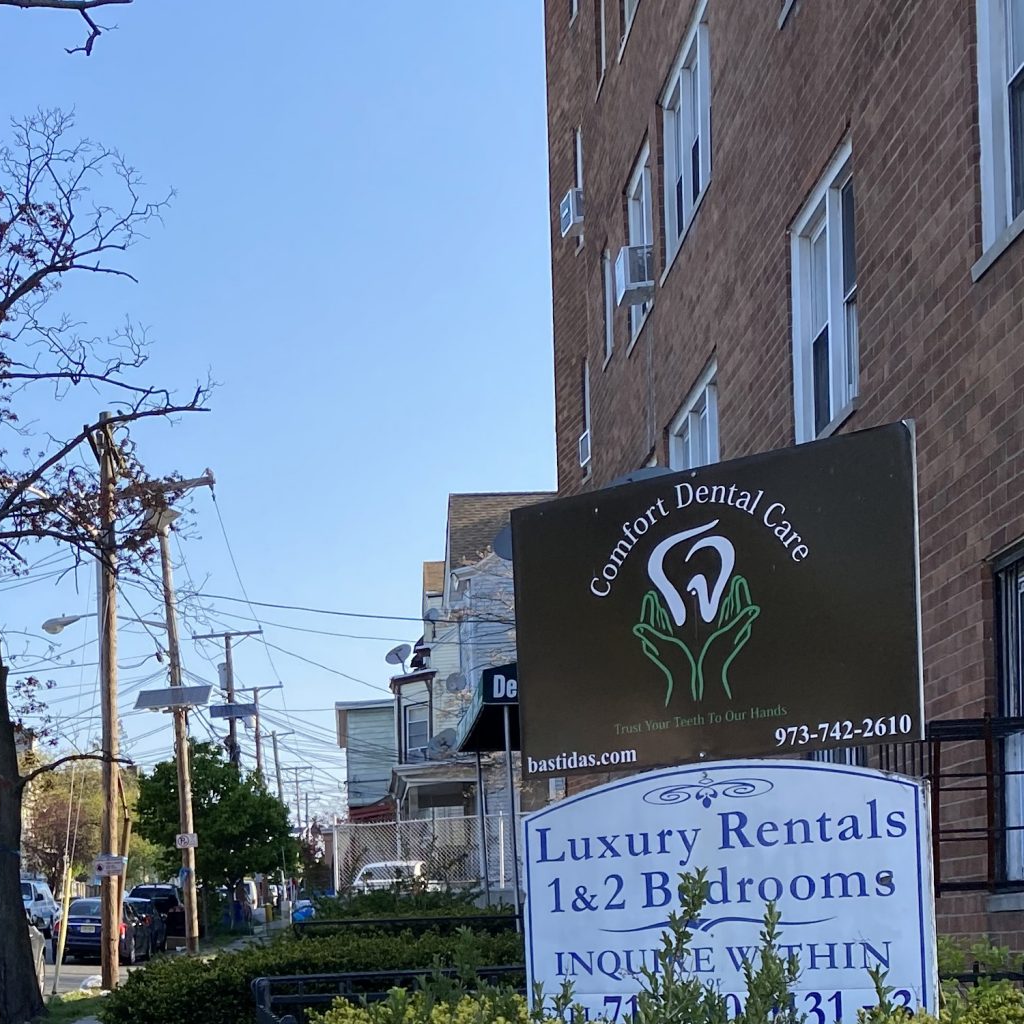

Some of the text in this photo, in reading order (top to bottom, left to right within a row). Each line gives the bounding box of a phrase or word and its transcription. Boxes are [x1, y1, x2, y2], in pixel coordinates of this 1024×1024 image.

[590, 482, 810, 597] Comfort Dental Care
[614, 704, 788, 735] Trust Your Teeth To Our Hands
[775, 713, 912, 747] 973-742-2610
[527, 748, 638, 774] bastidas.com
[536, 800, 908, 866] Luxury Rentals
[548, 867, 896, 913] 1&2 Bdrooms
[726, 941, 892, 970] WTHIN
